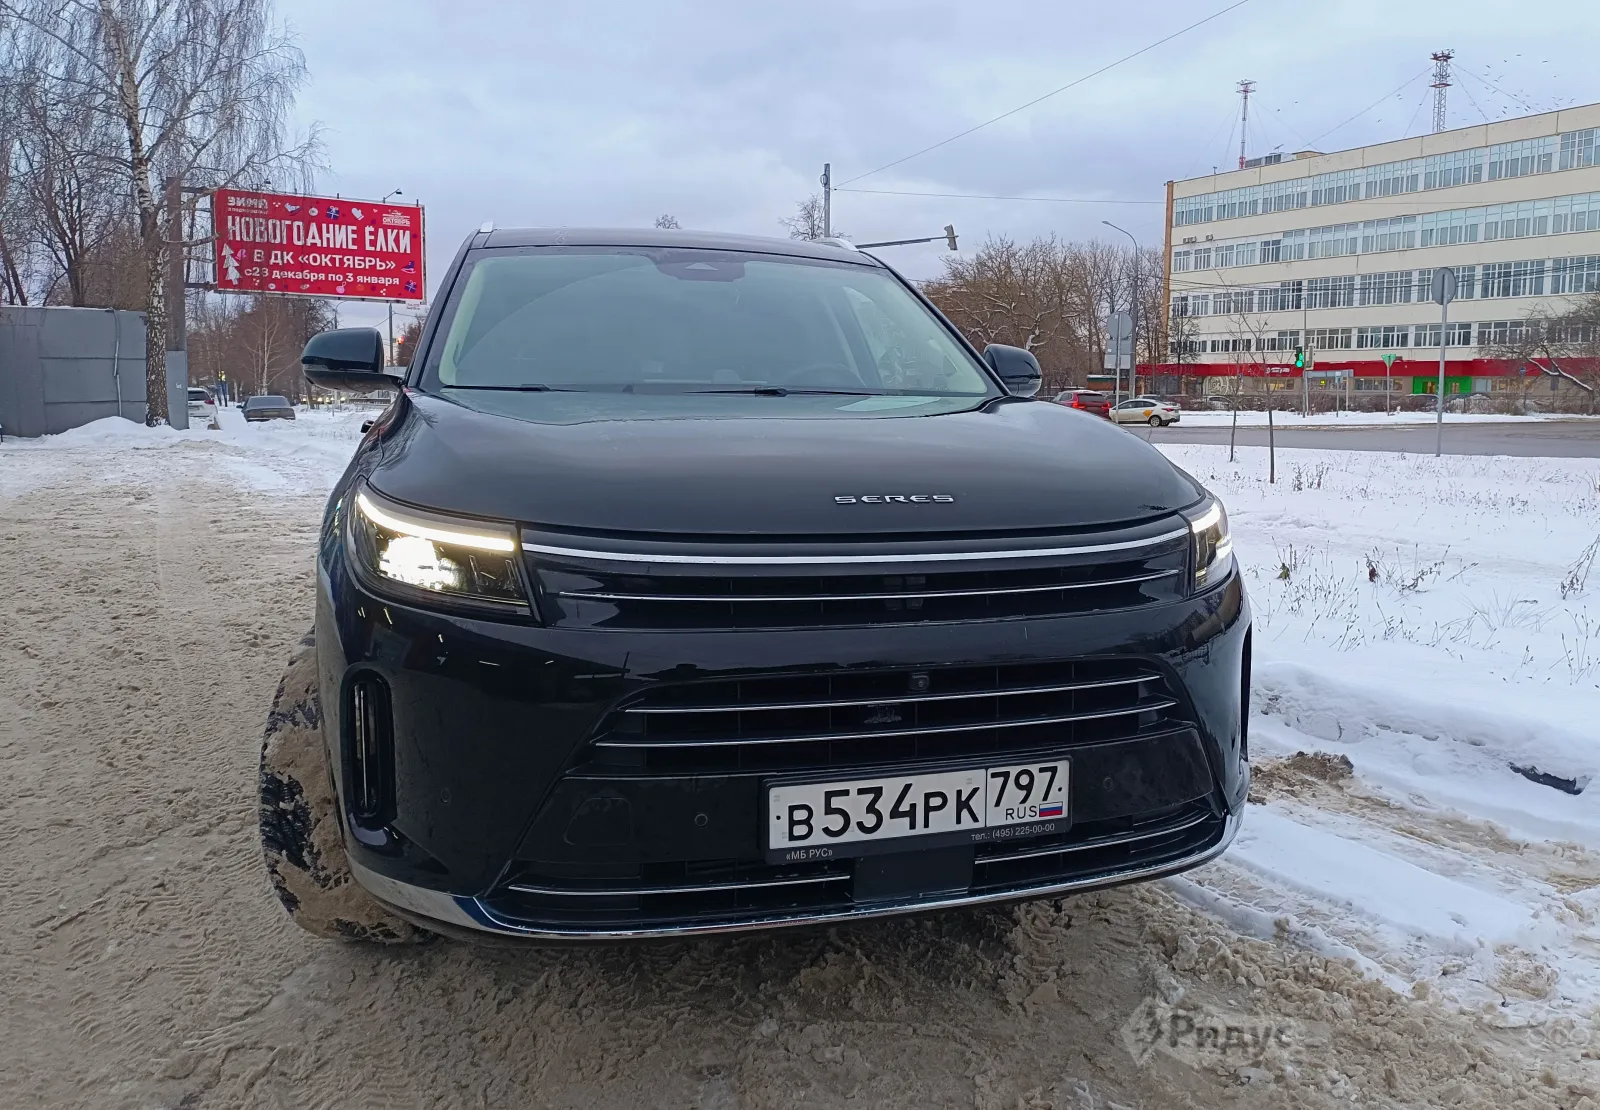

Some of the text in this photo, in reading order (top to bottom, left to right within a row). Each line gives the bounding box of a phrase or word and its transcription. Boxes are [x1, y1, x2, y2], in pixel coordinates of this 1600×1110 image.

[227, 215, 411, 253] НОВОГОДНИЕ ЁЛКИ
[253, 249, 396, 270] В ДК «ОКТЯБРЬ»
[272, 269, 325, 282] декабря
[328, 273, 343, 282] по
[346, 271, 354, 282] 3
[357, 275, 400, 285] января
[834, 495, 954, 504] SERES
[788, 766, 1058, 842] В534РК 797
[1005, 804, 1037, 821] RUS
[971, 823, 1055, 842] тел.: (495) 225-00-00
[786, 848, 833, 861] «МБ РУС»
